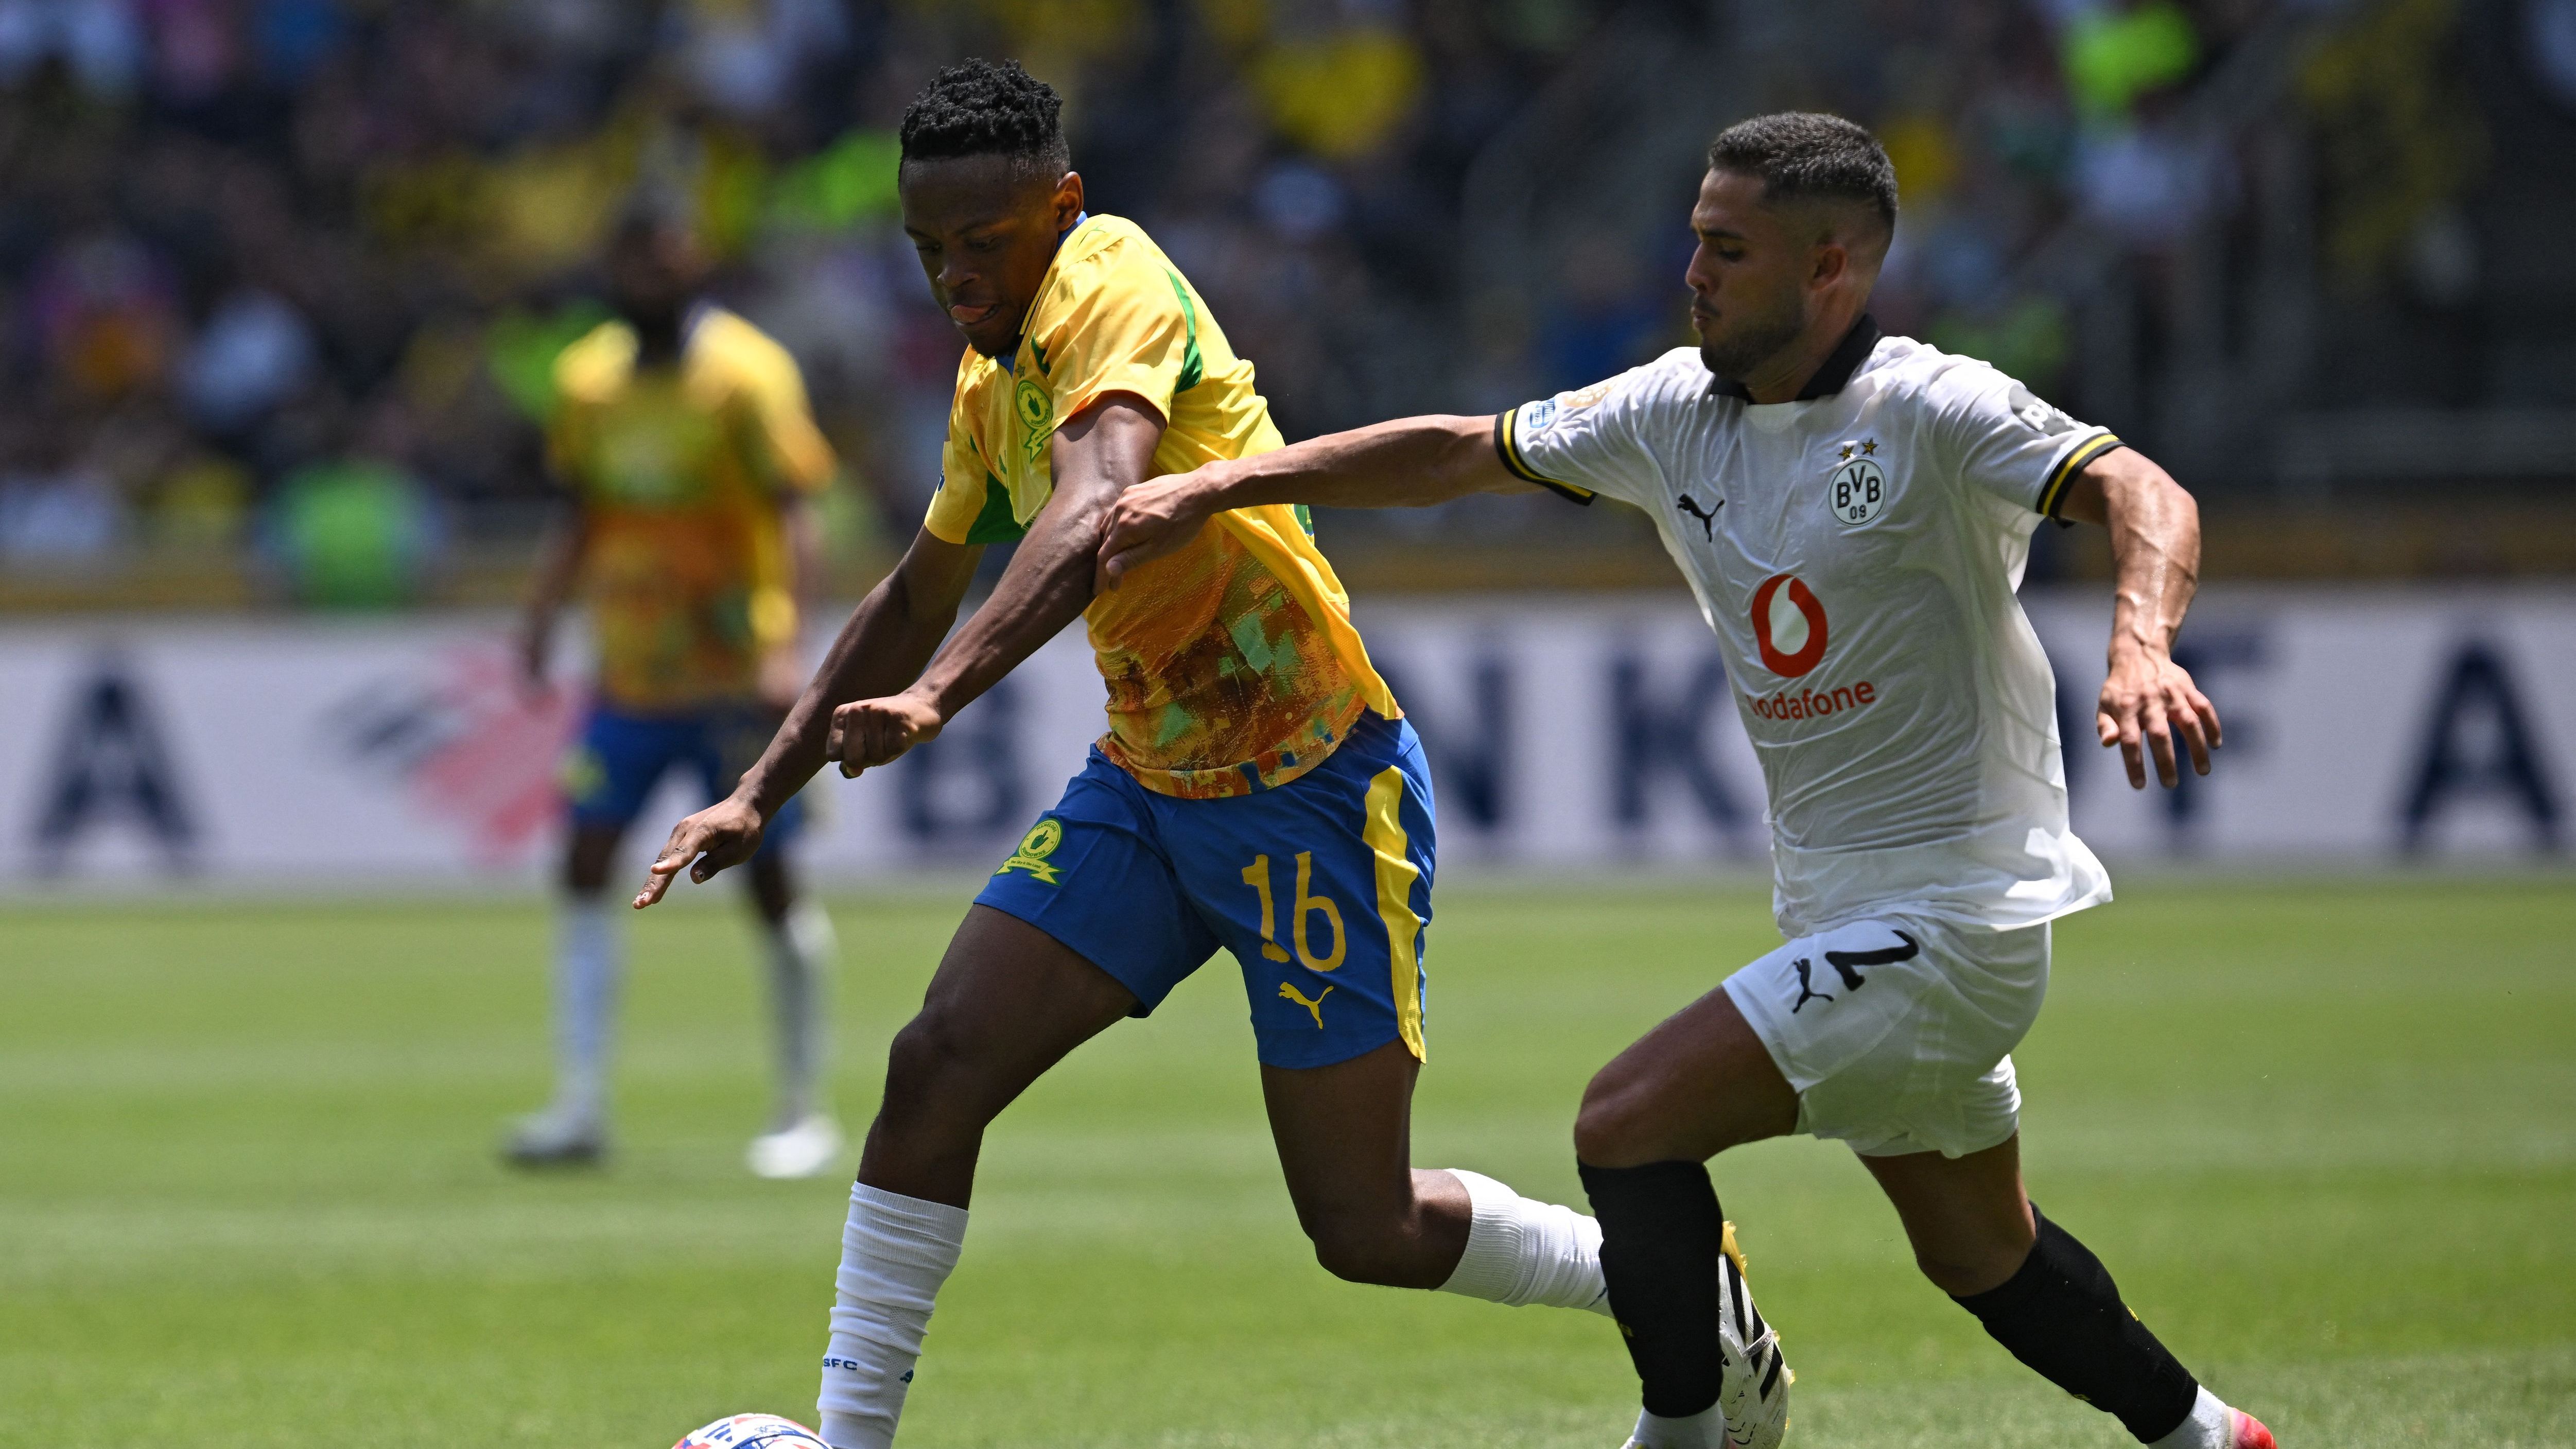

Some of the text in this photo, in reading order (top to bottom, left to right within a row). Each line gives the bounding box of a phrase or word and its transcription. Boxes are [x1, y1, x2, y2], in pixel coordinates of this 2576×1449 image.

[1837, 465, 1882, 509] BVB
[1850, 503, 1867, 520] 09
[1746, 680, 1876, 720] vodafone
[1022, 846, 1046, 857] SUNDOWNS
[1241, 850, 1346, 972] 16
[1825, 929, 1919, 991] 2
